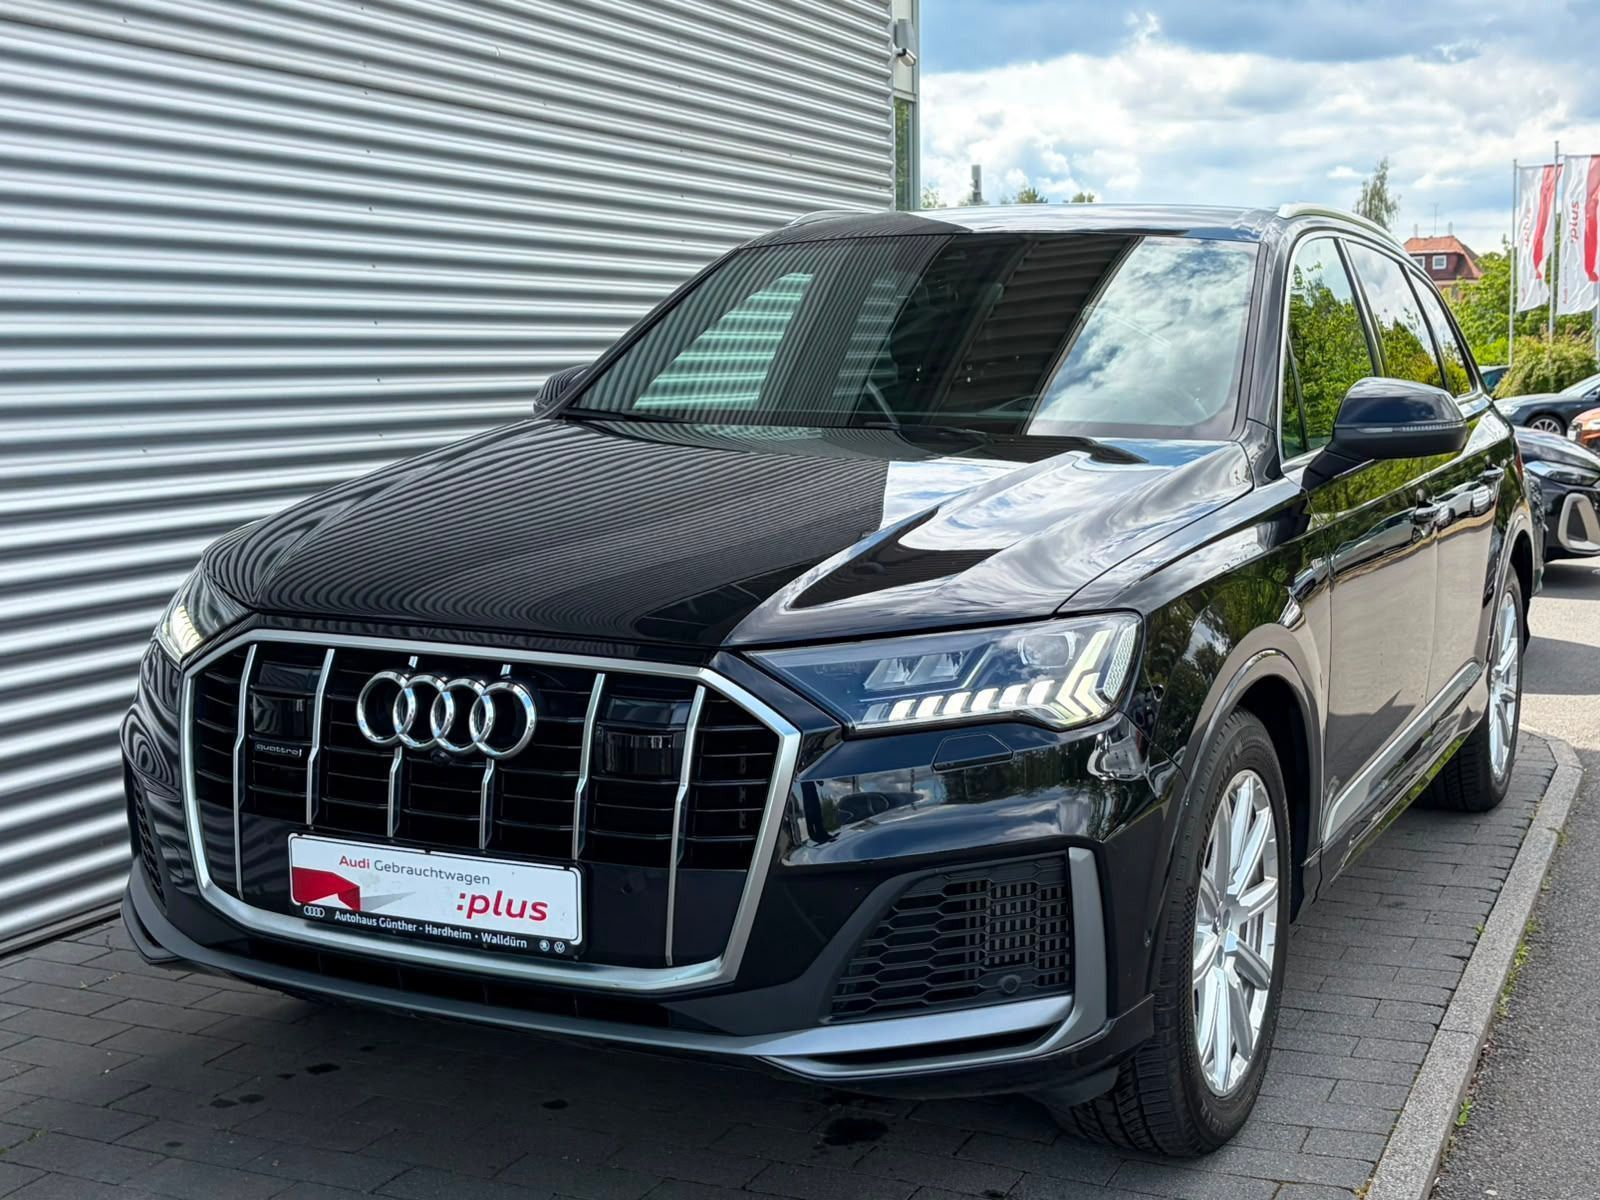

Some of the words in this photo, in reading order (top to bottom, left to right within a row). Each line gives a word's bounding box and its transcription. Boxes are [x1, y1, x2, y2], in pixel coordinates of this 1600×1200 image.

[256, 743, 299, 755] quattro
[339, 855, 370, 869] Audi
[374, 860, 490, 885] Gebrauchtwagen
[334, 910, 377, 926] Autohaus
[379, 917, 417, 931] Günther
[425, 924, 472, 940] Hardheim
[481, 932, 527, 948] Walldürn
